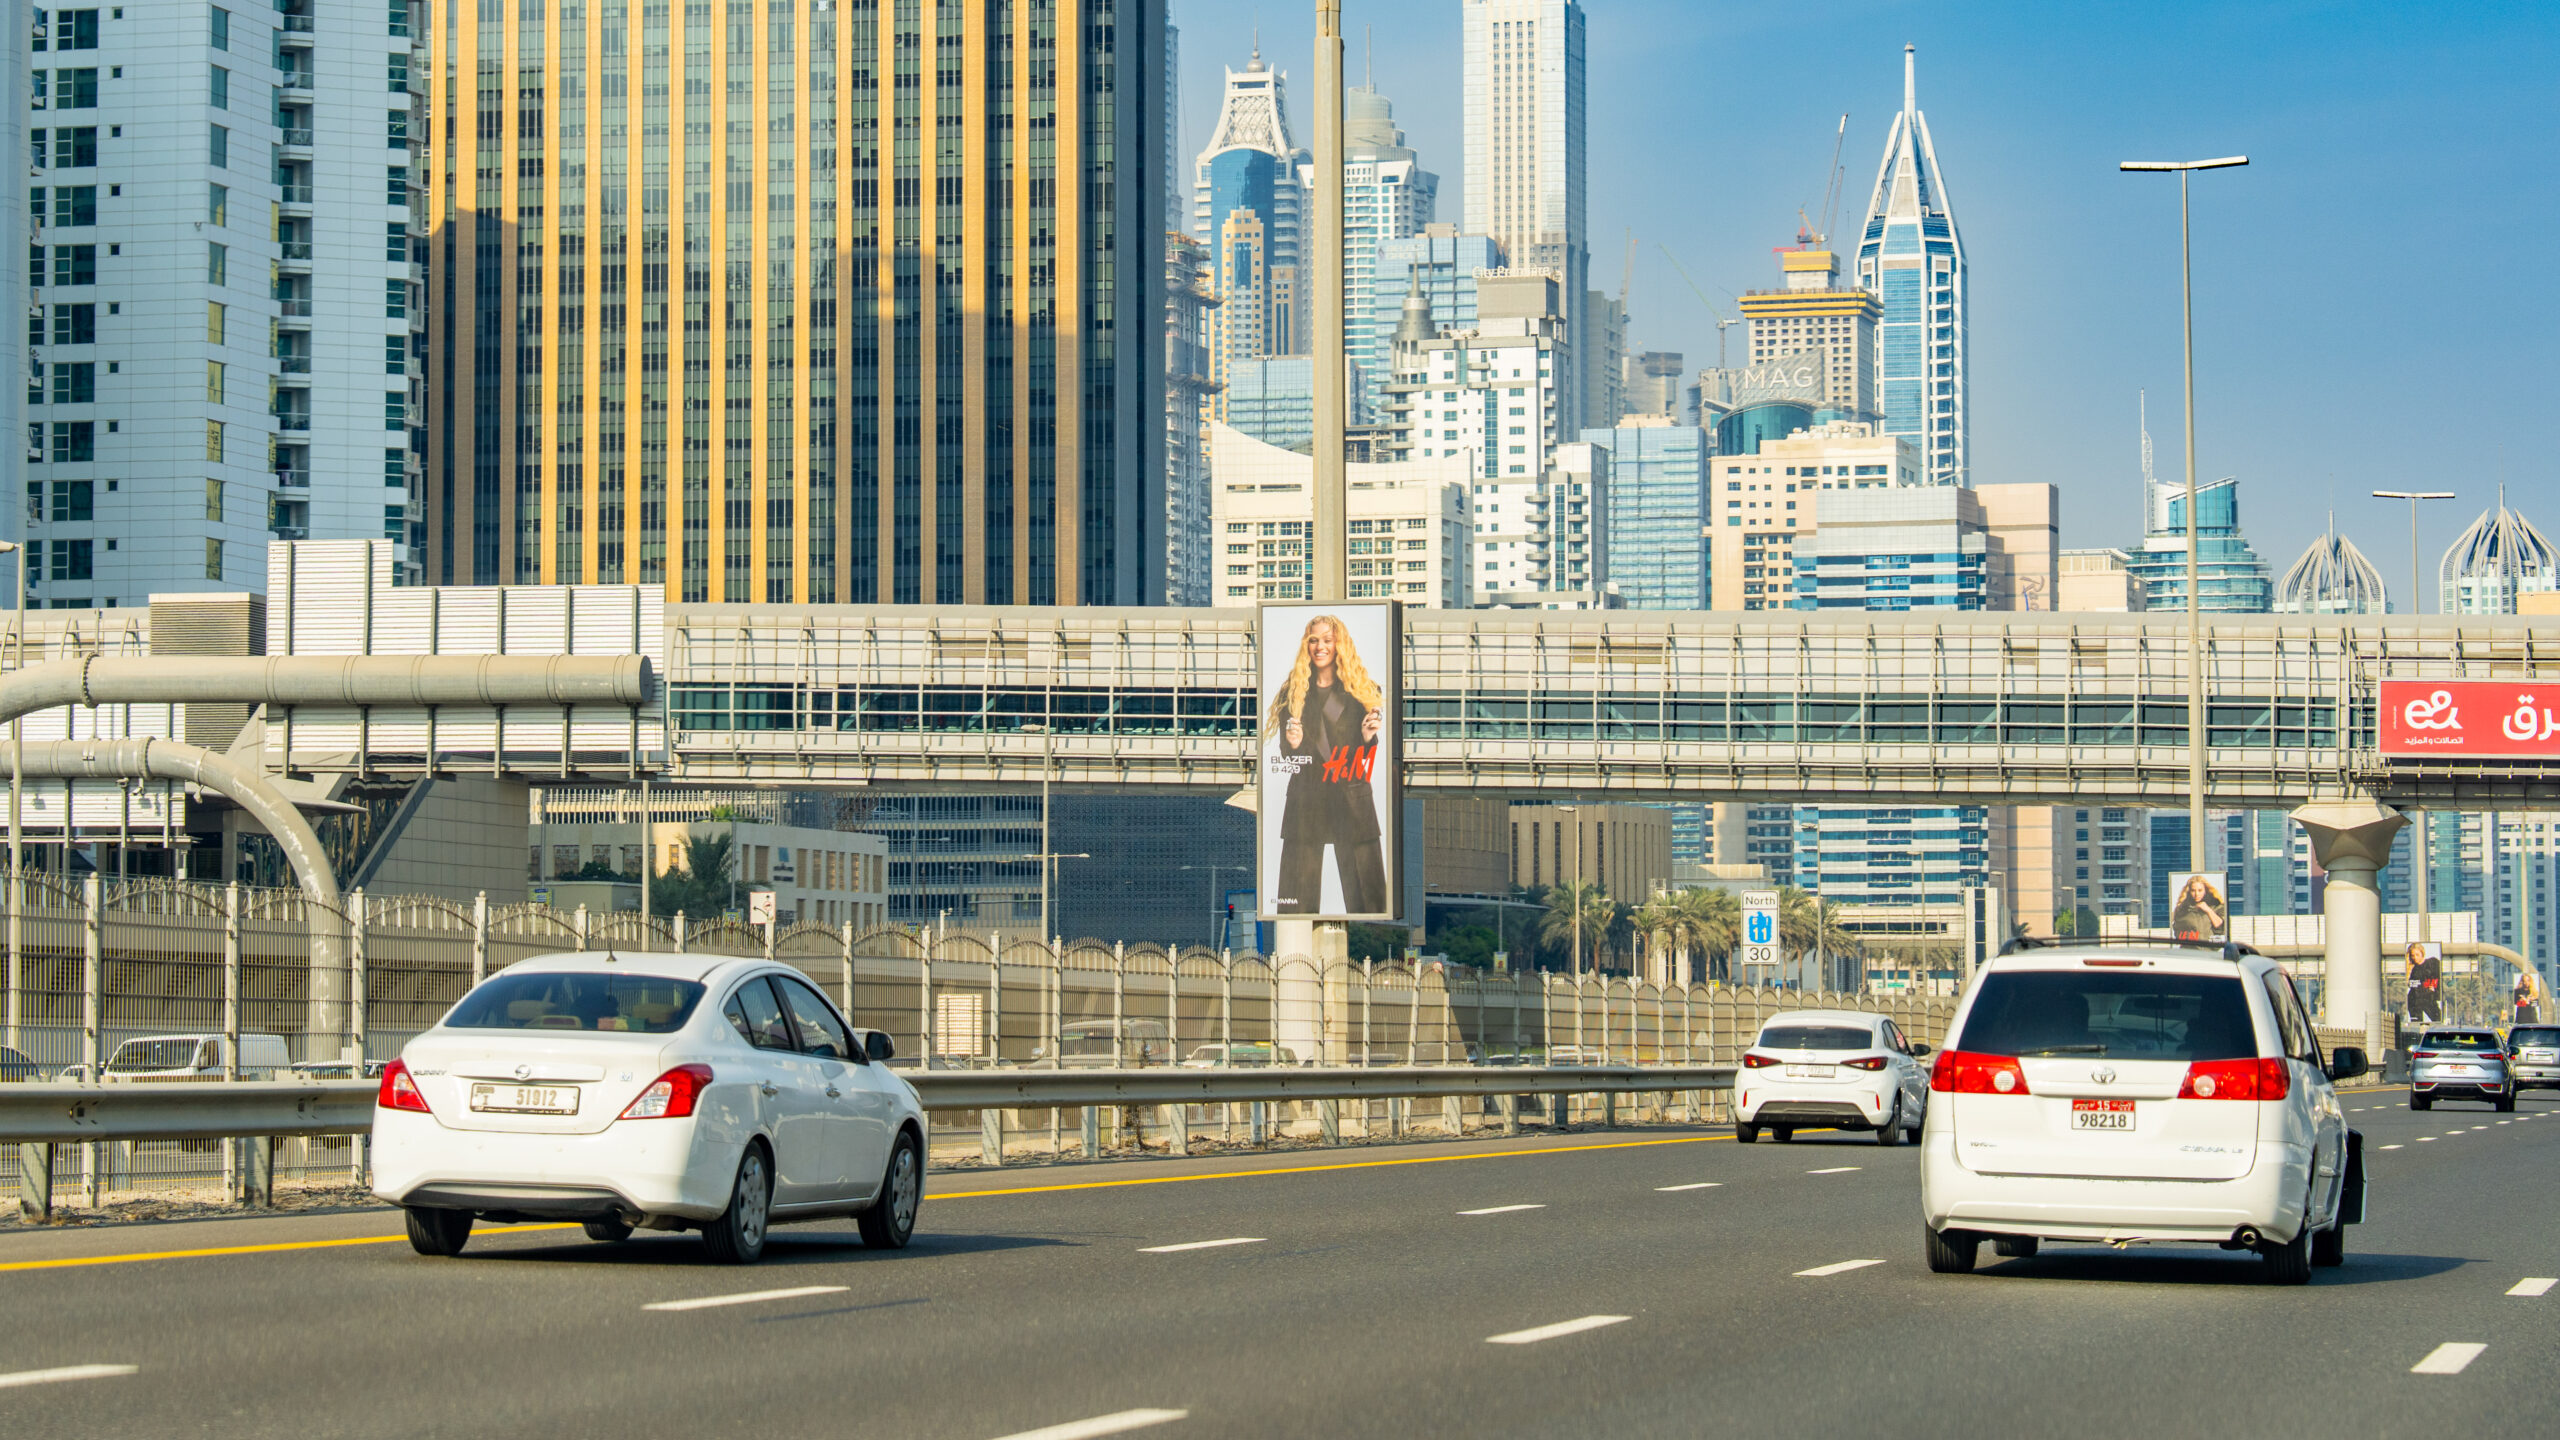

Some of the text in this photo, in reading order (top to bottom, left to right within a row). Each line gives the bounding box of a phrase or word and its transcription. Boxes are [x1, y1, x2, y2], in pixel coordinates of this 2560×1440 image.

[1744, 366, 1813, 389] MAG
[1270, 755, 1313, 765] BLAZER
[1321, 745, 1378, 784] H&M
[1281, 765, 1301, 774] 429
[1745, 896, 1776, 906] North
[1753, 927, 1767, 941] 11
[1749, 946, 1771, 961] 30
[516, 1088, 558, 1107] 51912
[2097, 1100, 2111, 1110] 15
[2080, 1113, 2127, 1128] 98218
